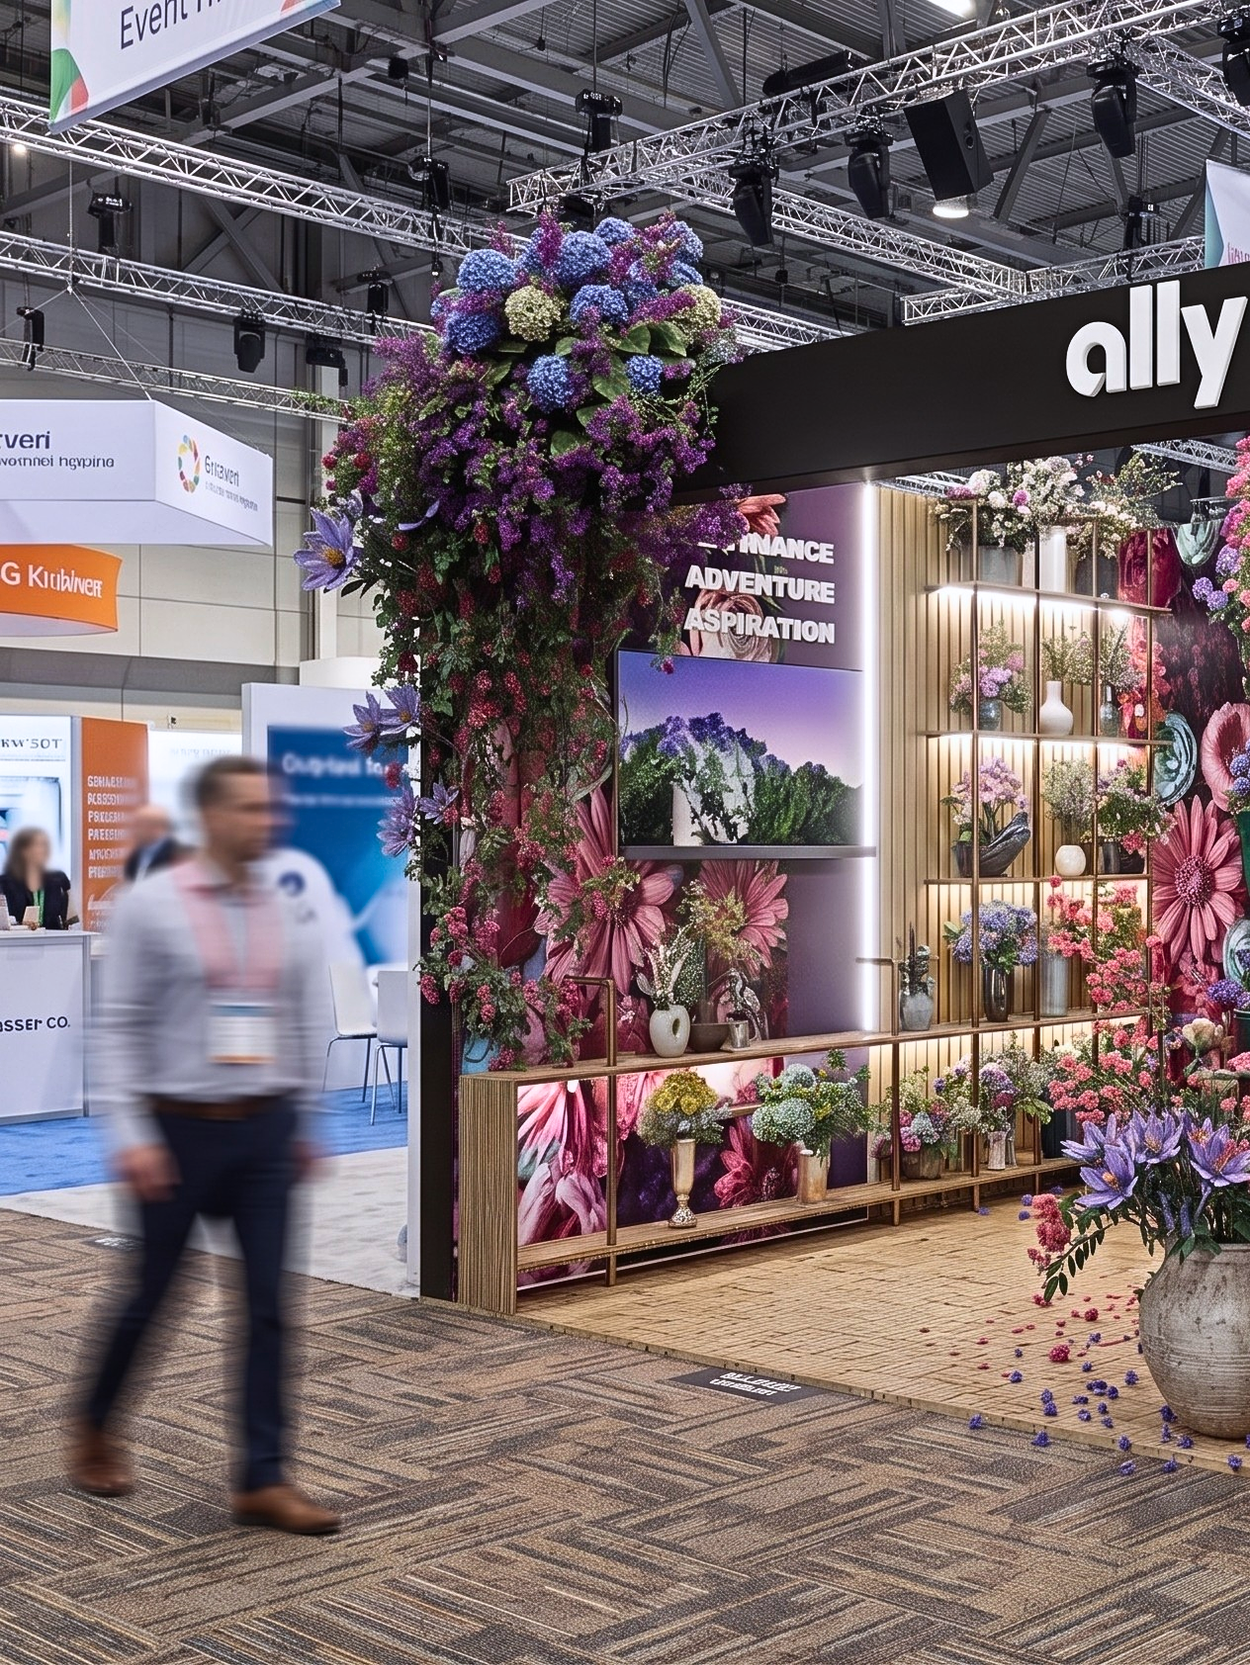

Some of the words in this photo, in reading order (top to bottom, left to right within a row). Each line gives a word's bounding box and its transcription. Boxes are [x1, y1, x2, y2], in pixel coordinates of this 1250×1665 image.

[120, 0, 188, 50] Event
[1066, 280, 1248, 409] ally
[685, 565, 835, 604] ADVENTURE
[683, 607, 835, 644] ASPIRATION
